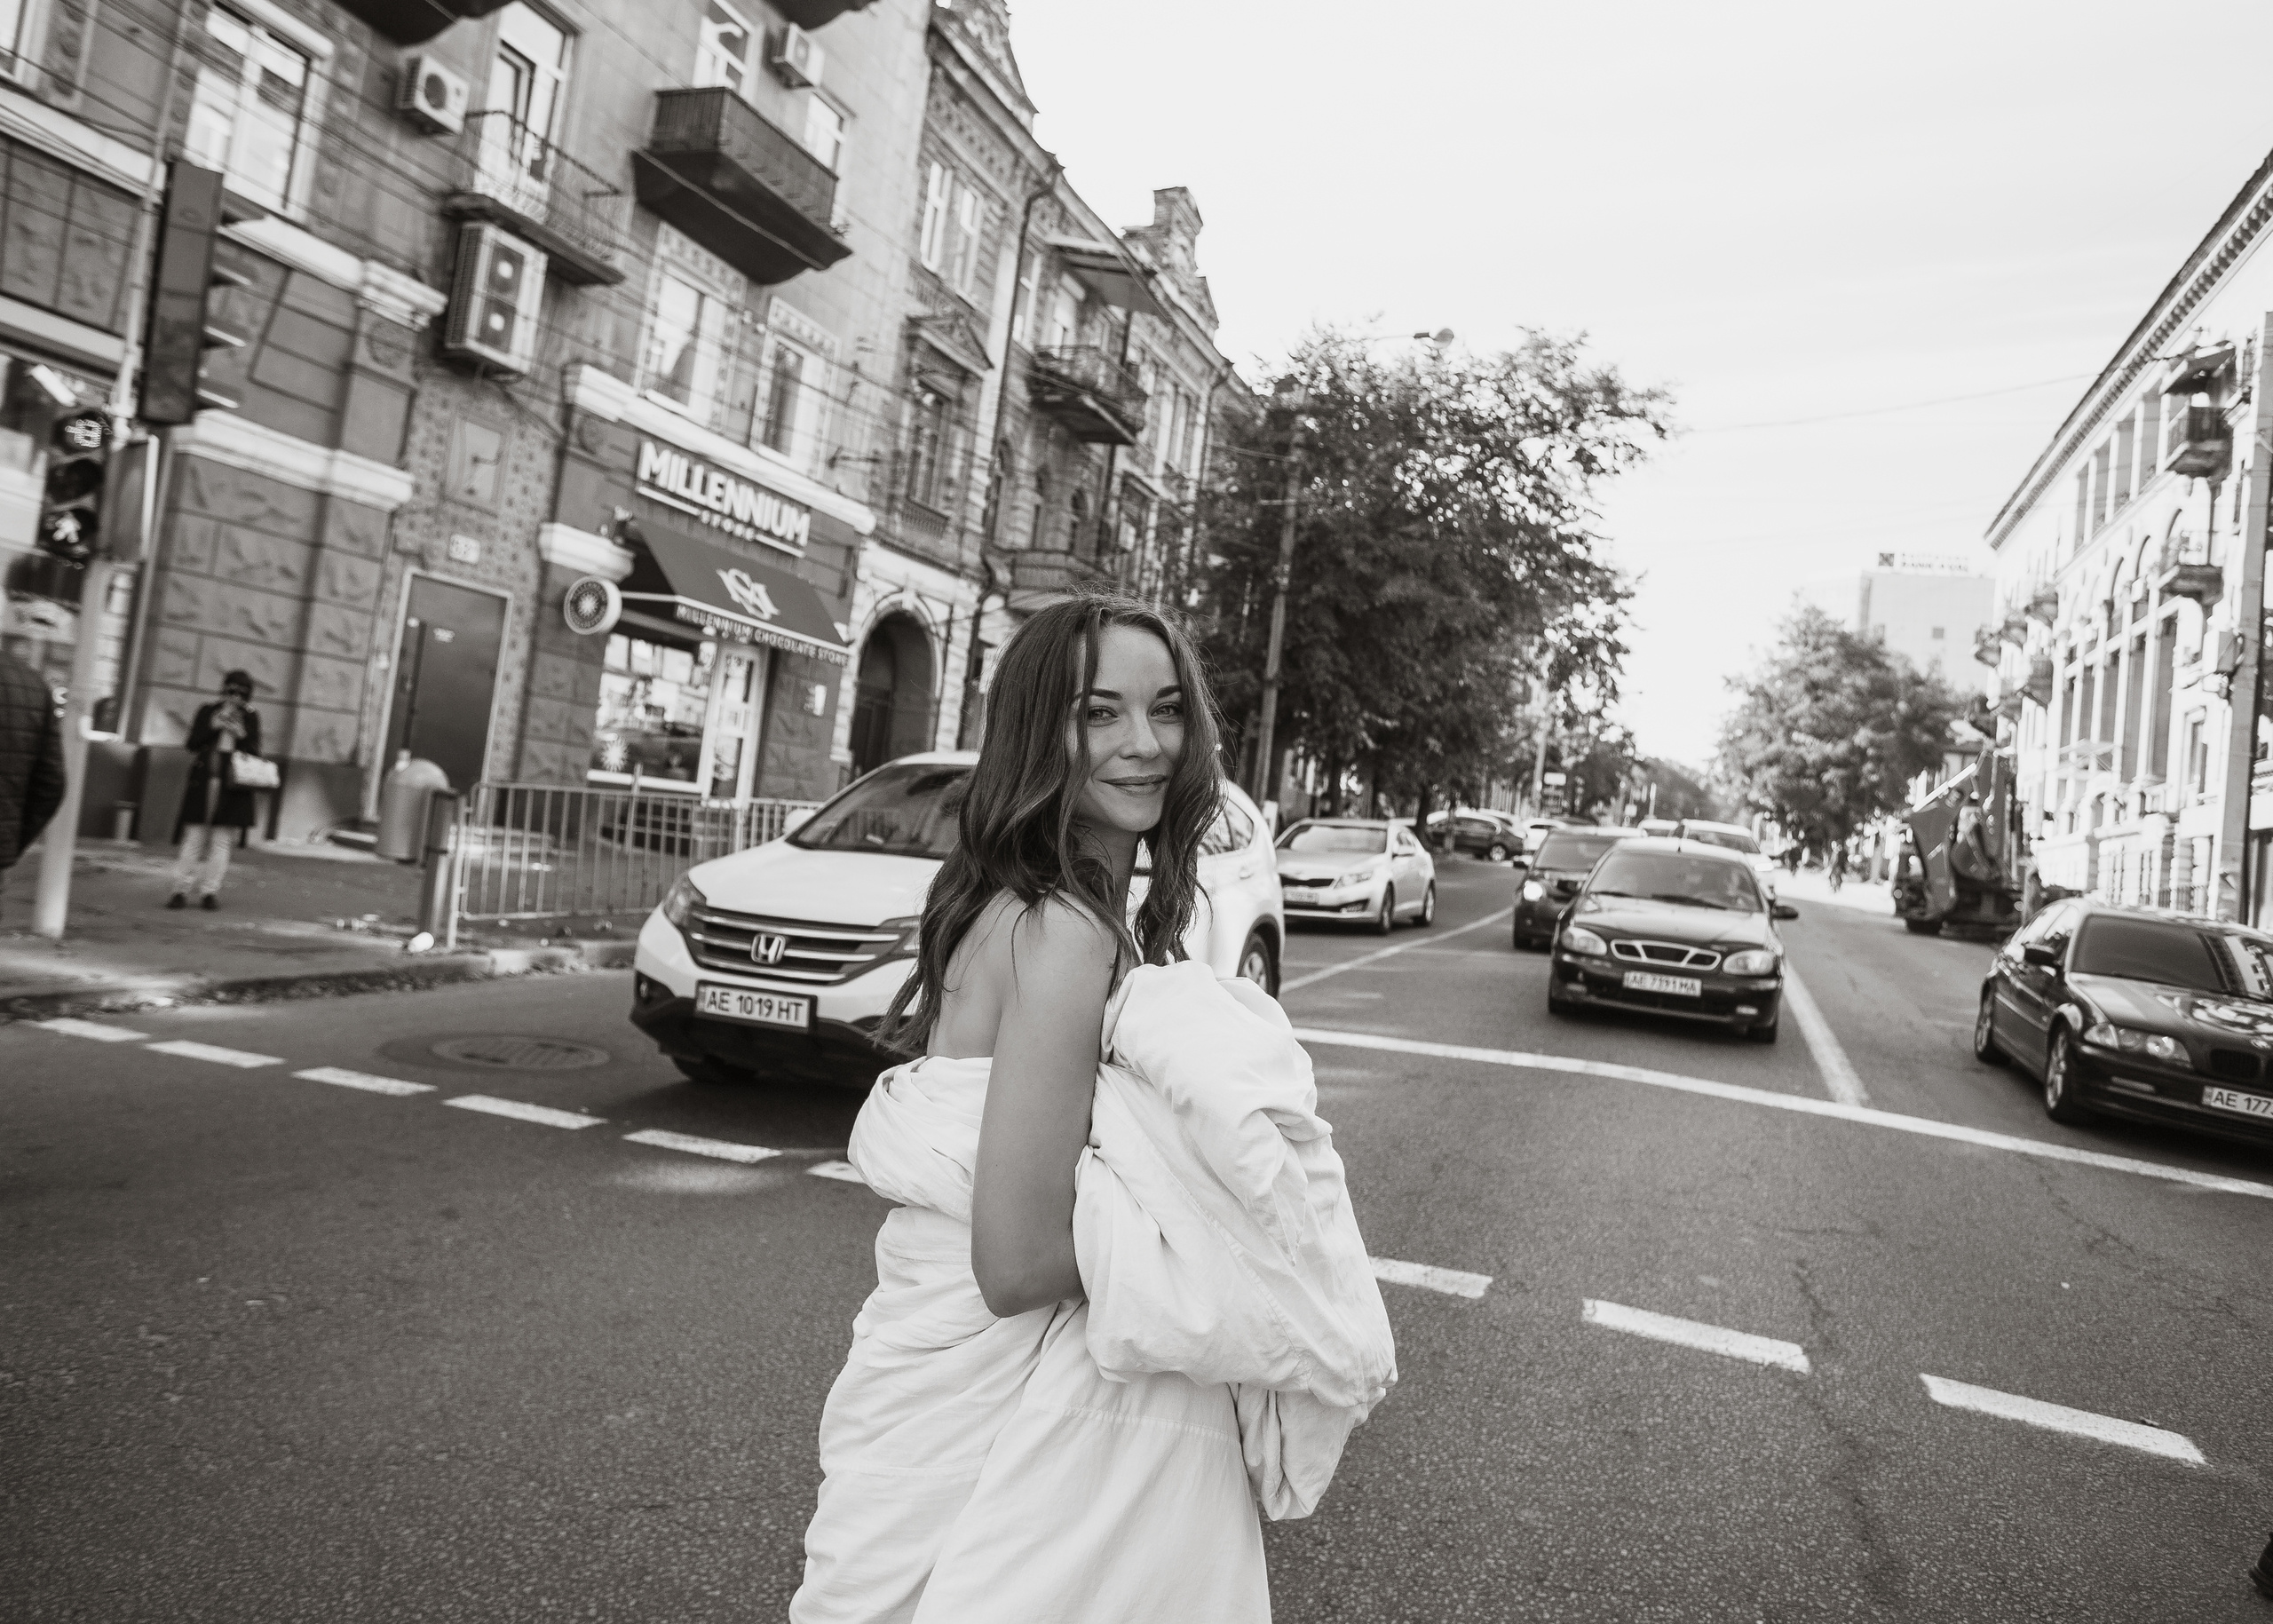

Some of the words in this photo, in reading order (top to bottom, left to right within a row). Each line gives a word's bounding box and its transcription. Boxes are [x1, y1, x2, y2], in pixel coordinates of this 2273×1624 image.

[638, 441, 812, 547] MILLENNIUM
[677, 604, 753, 638] MILLENNIUM
[755, 629, 817, 658] CHOCOLATE
[707, 990, 730, 1012] AE
[735, 994, 773, 1018] 1019
[777, 1000, 803, 1021] HT
[2212, 1091, 2237, 1108] AE
